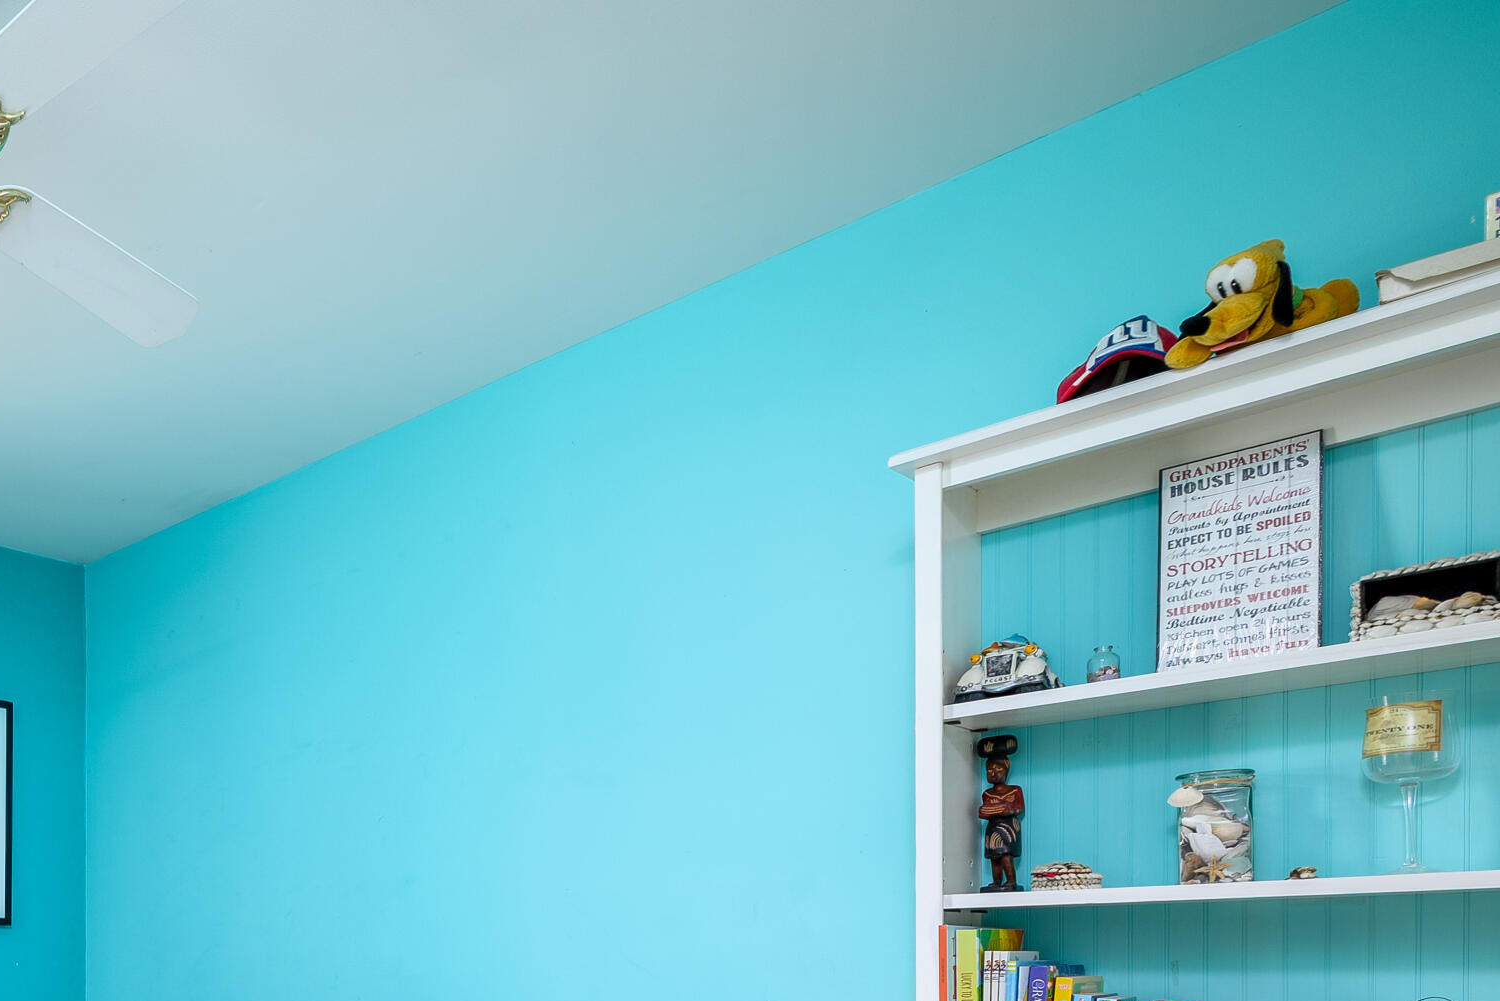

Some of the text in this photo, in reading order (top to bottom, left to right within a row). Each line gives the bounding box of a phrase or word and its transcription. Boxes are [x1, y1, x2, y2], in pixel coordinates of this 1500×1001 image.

[1170, 454, 1310, 498] HOUSE RULES
[1167, 486, 1311, 525] Grandkids Welcome
[1168, 499, 1310, 536] Parents by Appointment
[1167, 511, 1311, 550] EXPECT TO BE SPOILED
[1167, 538, 1313, 578] STORYTELLING
[1167, 556, 1309, 591] PLAY LOTS OF GAMES
[1166, 571, 1311, 603] endless hugs & kisses
[1166, 584, 1310, 617] SLEEPOVERS WELCOME
[1165, 596, 1311, 630] Bedtime Negotiable
[1218, 623, 1249, 636] open
[1271, 610, 1311, 625] hours
[1223, 631, 1266, 647] comes
[1228, 644, 1270, 659] have
[1275, 638, 1309, 651] fun
[961, 972, 973, 989] LUCKY
